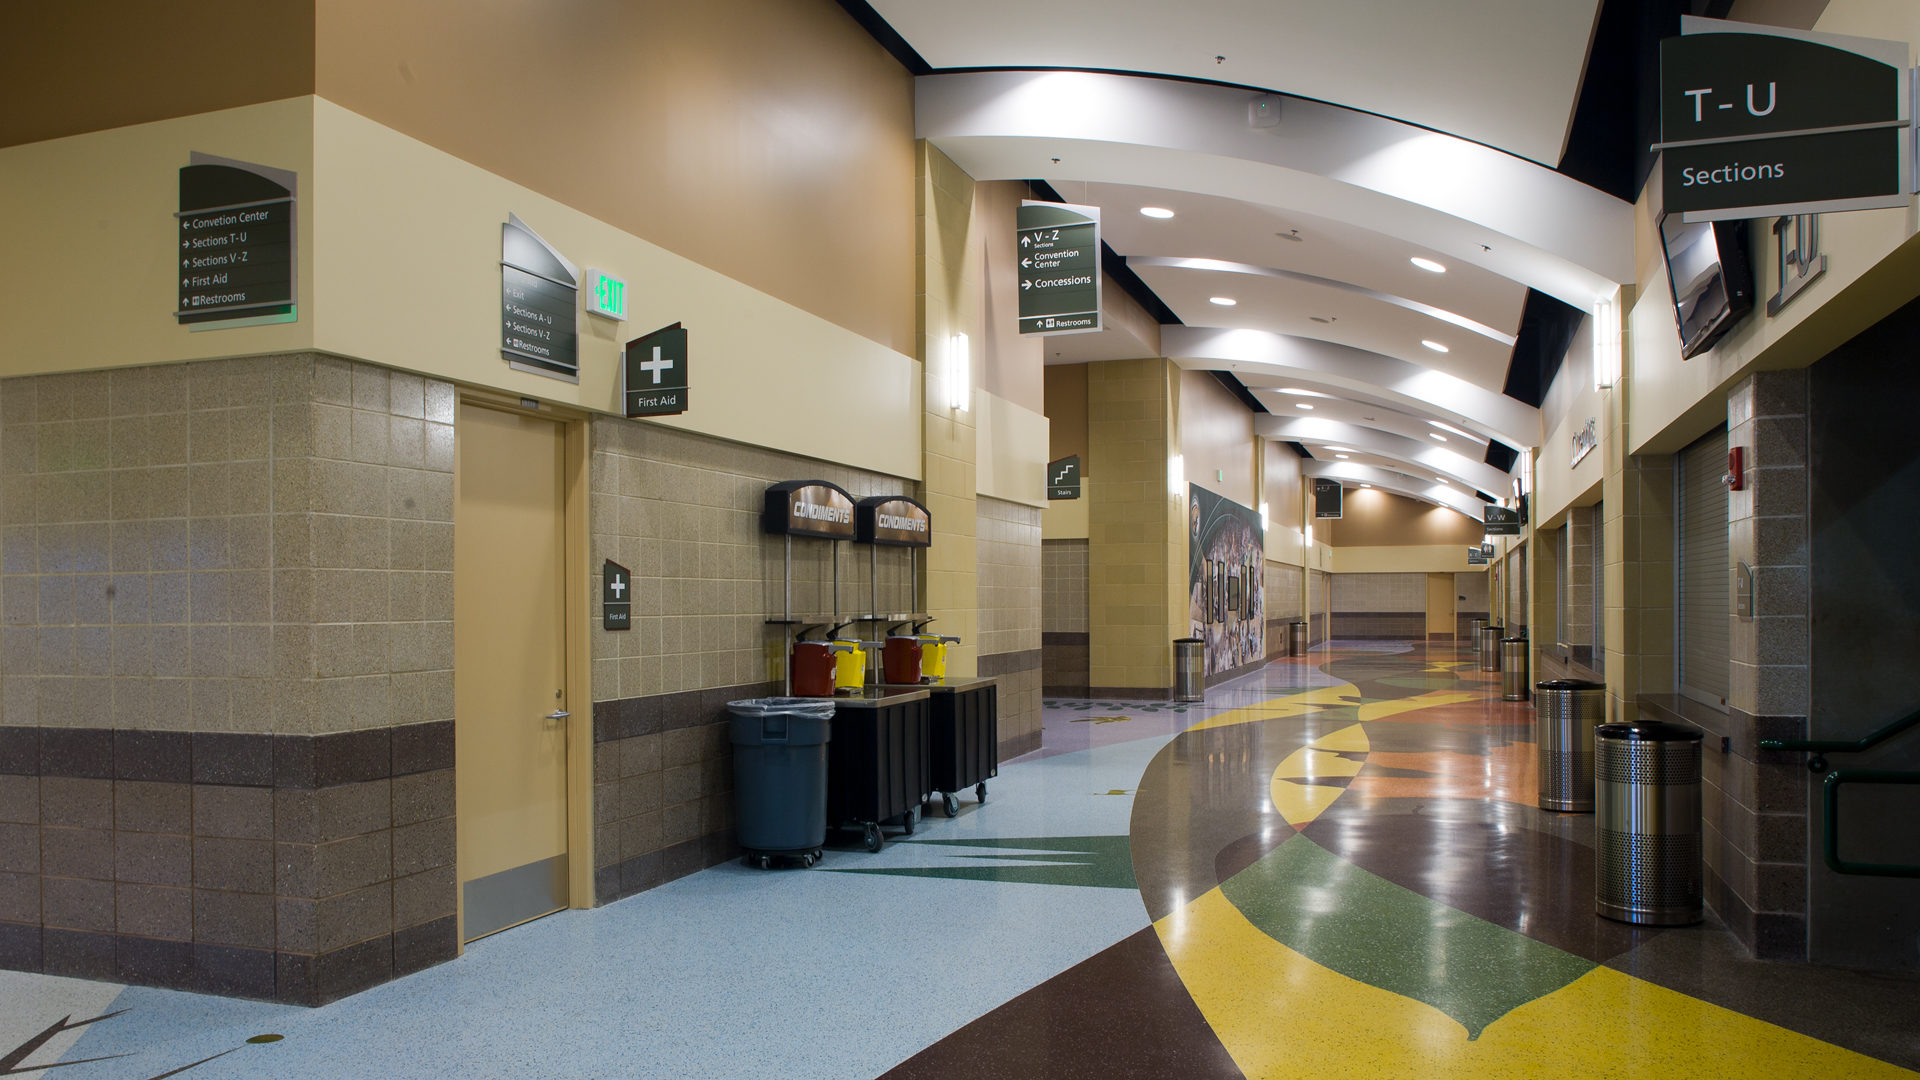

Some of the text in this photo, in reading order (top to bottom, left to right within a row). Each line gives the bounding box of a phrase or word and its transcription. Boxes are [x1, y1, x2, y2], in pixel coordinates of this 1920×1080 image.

[1682, 162, 1785, 187] Sections
[192, 210, 269, 229] Convetion Center
[192, 235, 228, 249] Sections
[192, 255, 228, 268] Sections
[1034, 249, 1079, 261] Convention
[1034, 259, 1061, 269] Center
[192, 272, 228, 288] First Aid
[1035, 275, 1092, 289] Concessions
[200, 292, 246, 305] Restrooms
[512, 288, 525, 301] Exit
[599, 275, 624, 316] EXIT
[512, 305, 538, 321] Sections
[512, 321, 538, 337] Sections
[1056, 317, 1092, 328] Restrooms
[519, 339, 550, 357] Restrooms
[638, 394, 677, 409] First Aid
[793, 501, 851, 524] CONDIMENTS
[878, 513, 926, 532] CONDIMENTS
